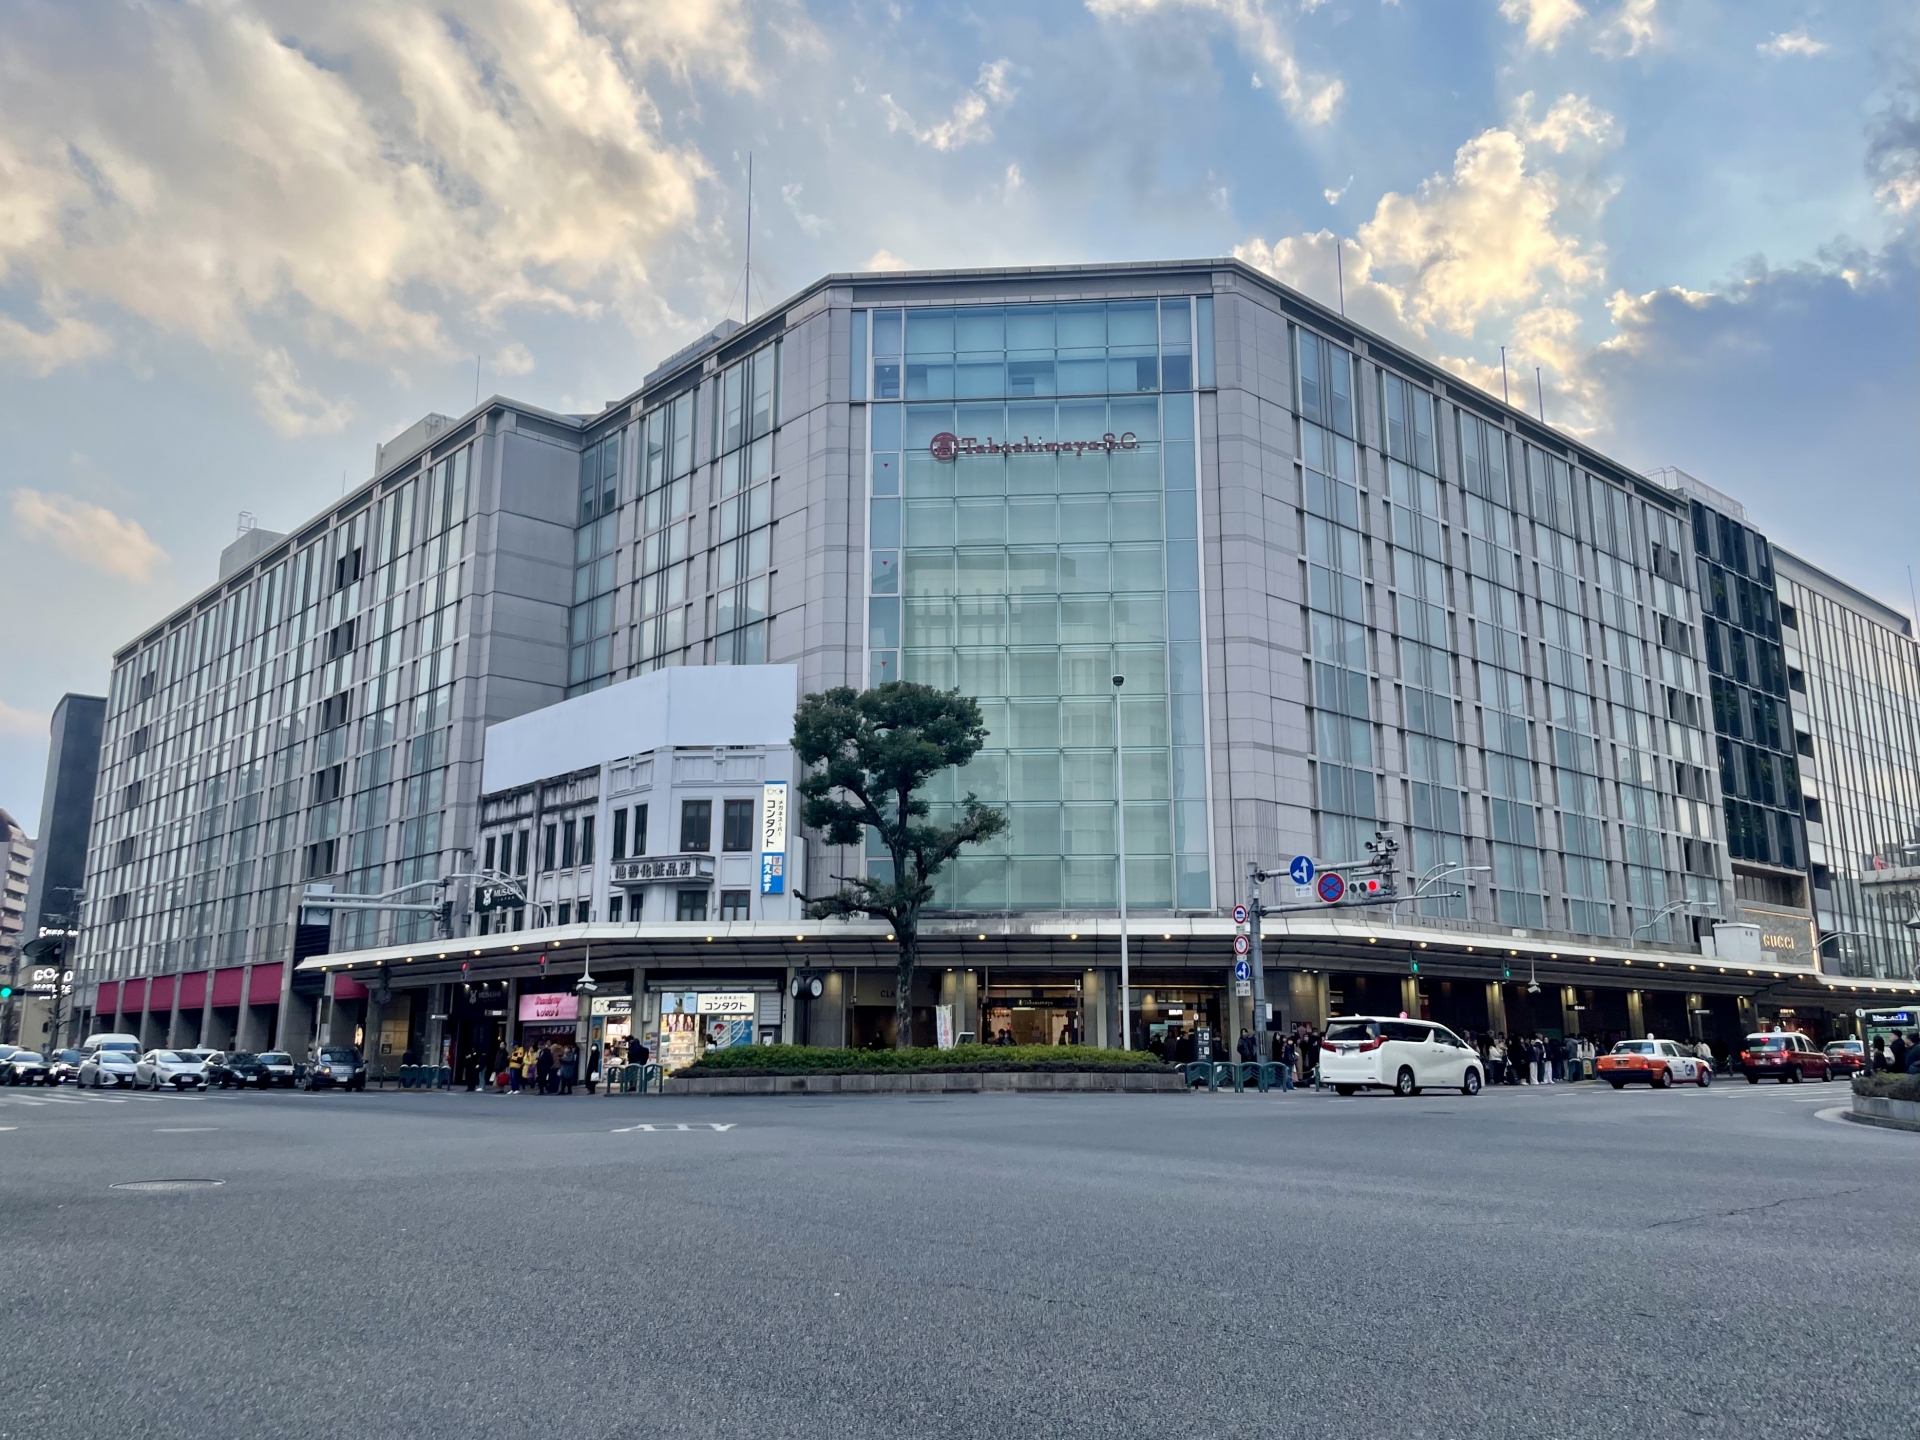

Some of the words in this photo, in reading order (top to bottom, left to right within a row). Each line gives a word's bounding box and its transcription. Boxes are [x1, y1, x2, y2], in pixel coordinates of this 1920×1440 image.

[961, 436, 1098, 456] Takashimaya
[765, 799, 776, 848] コンタクト
[762, 855, 773, 892] 買えます
[773, 856, 782, 875] すぐ
[1763, 934, 1795, 949] GUCCI
[705, 1002, 747, 1010] コンタクト
